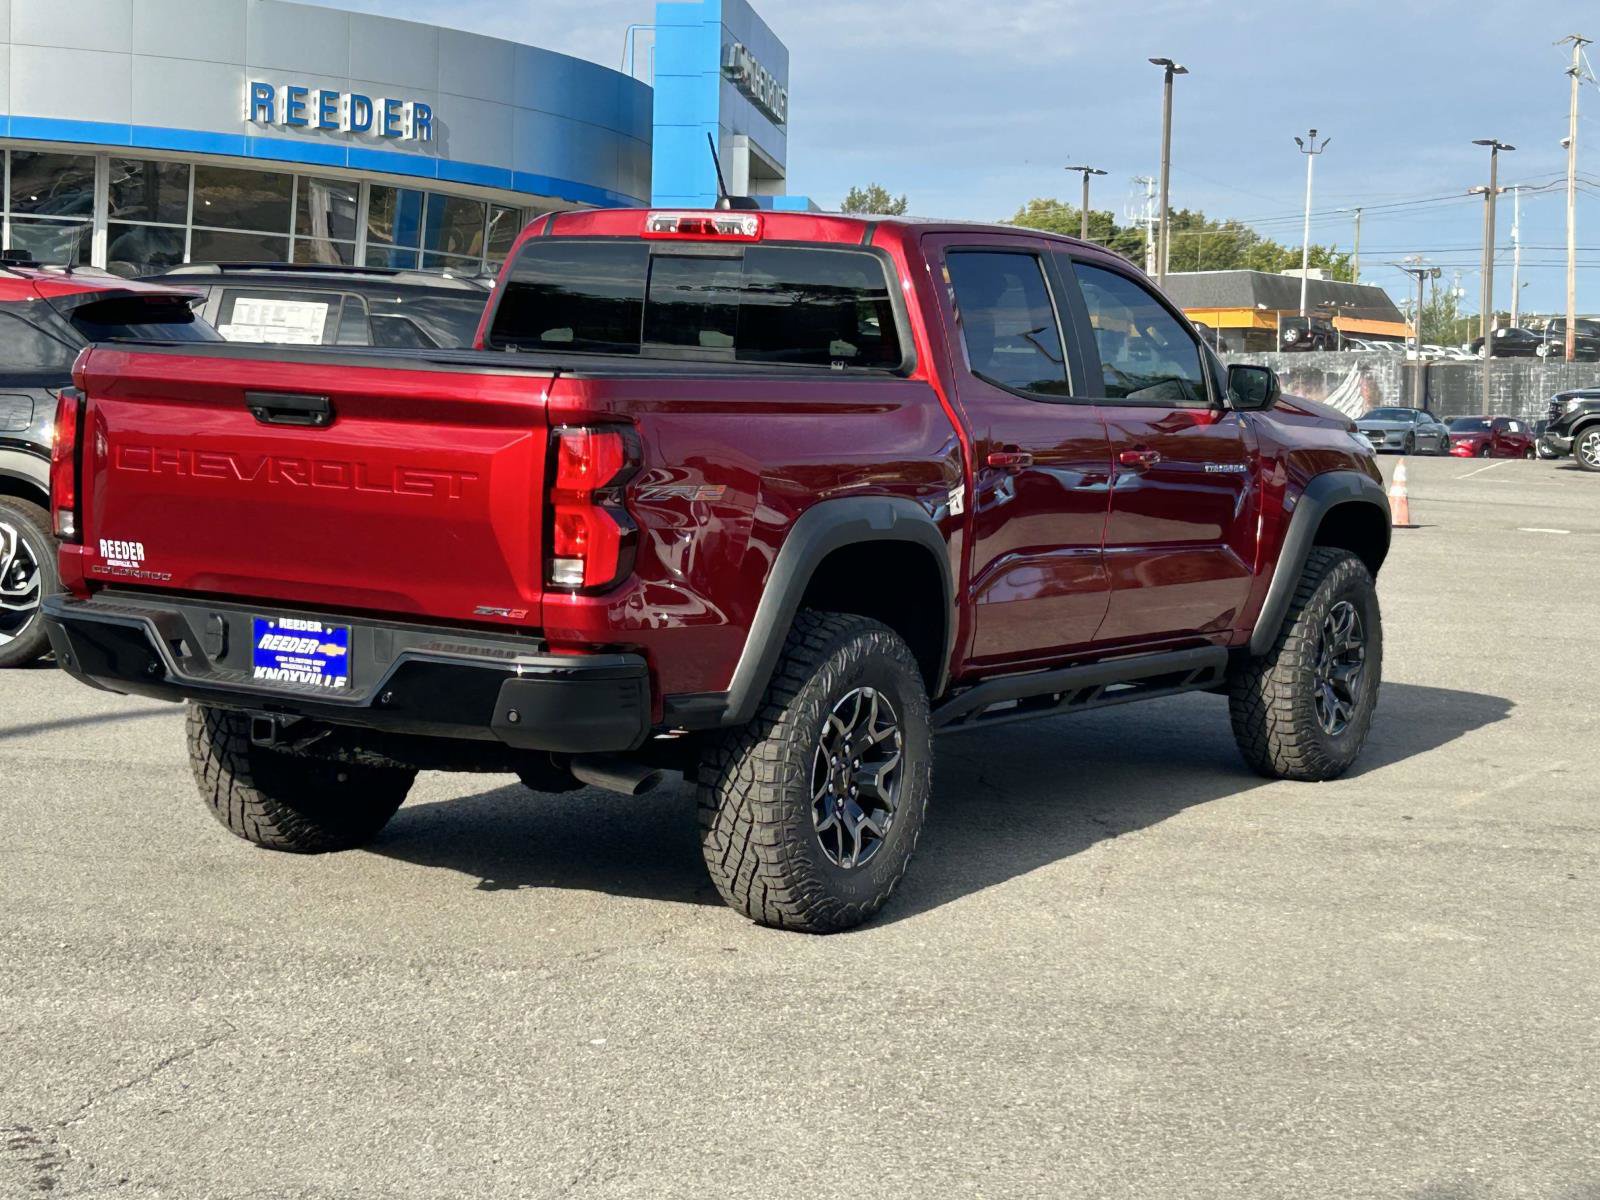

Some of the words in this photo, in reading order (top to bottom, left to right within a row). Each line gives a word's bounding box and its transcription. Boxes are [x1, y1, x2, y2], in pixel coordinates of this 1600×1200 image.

[246, 80, 434, 142] REEDER
[115, 445, 479, 499] CHEVROLET
[99, 538, 145, 561] REEDER
[278, 617, 323, 633] REEDER
[257, 633, 320, 655] REEDER
[253, 666, 347, 687] KNOXVILLE
